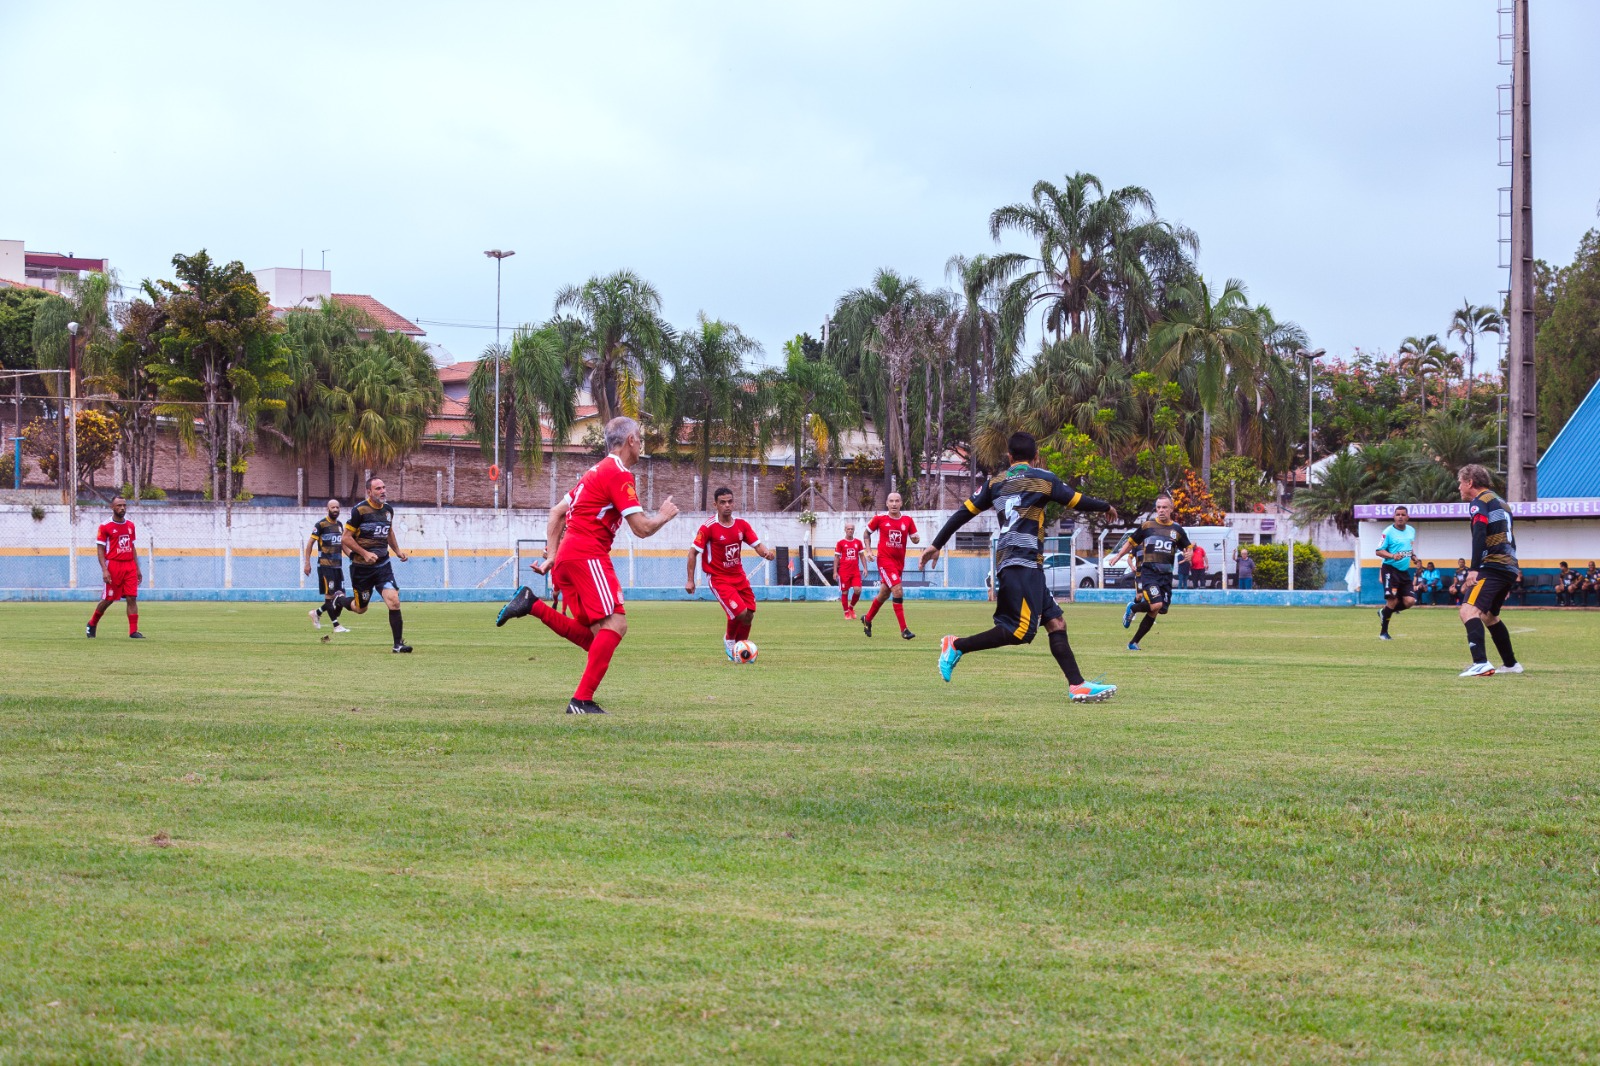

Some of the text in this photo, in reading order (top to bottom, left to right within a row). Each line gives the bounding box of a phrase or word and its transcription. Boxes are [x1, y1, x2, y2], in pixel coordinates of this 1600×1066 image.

[1375, 505, 1437, 516] SECTARIA
[1440, 504, 1455, 515] DE
[1530, 502, 1579, 514] ESPORTE
[1583, 502, 1590, 513] E
[1154, 539, 1173, 551] DG
